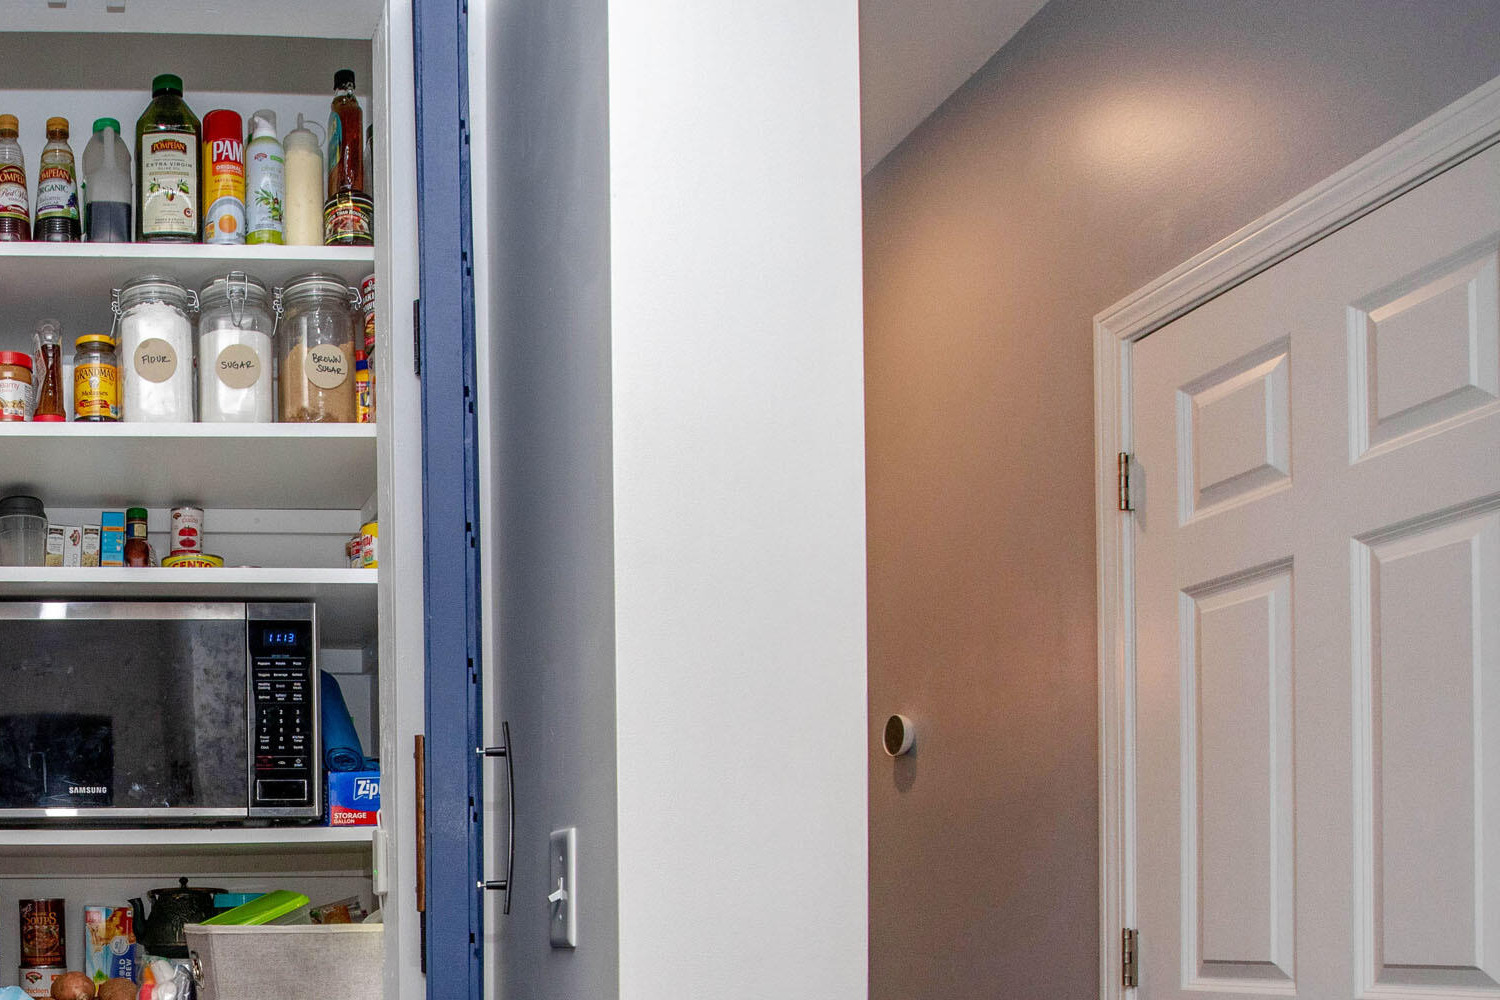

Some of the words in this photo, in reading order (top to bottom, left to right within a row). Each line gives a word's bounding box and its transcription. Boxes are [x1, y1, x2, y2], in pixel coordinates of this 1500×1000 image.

[153, 141, 186, 151] POMPEIAN
[212, 140, 244, 164] PAM
[41, 167, 71, 180] MPEIAN
[41, 185, 69, 194] RGANIC
[312, 353, 342, 364] BROWN
[220, 360, 255, 370] SUGAR
[316, 364, 346, 375] SUGAR
[68, 786, 107, 794] SAMSUNG
[26, 911, 57, 926] SOUPS
